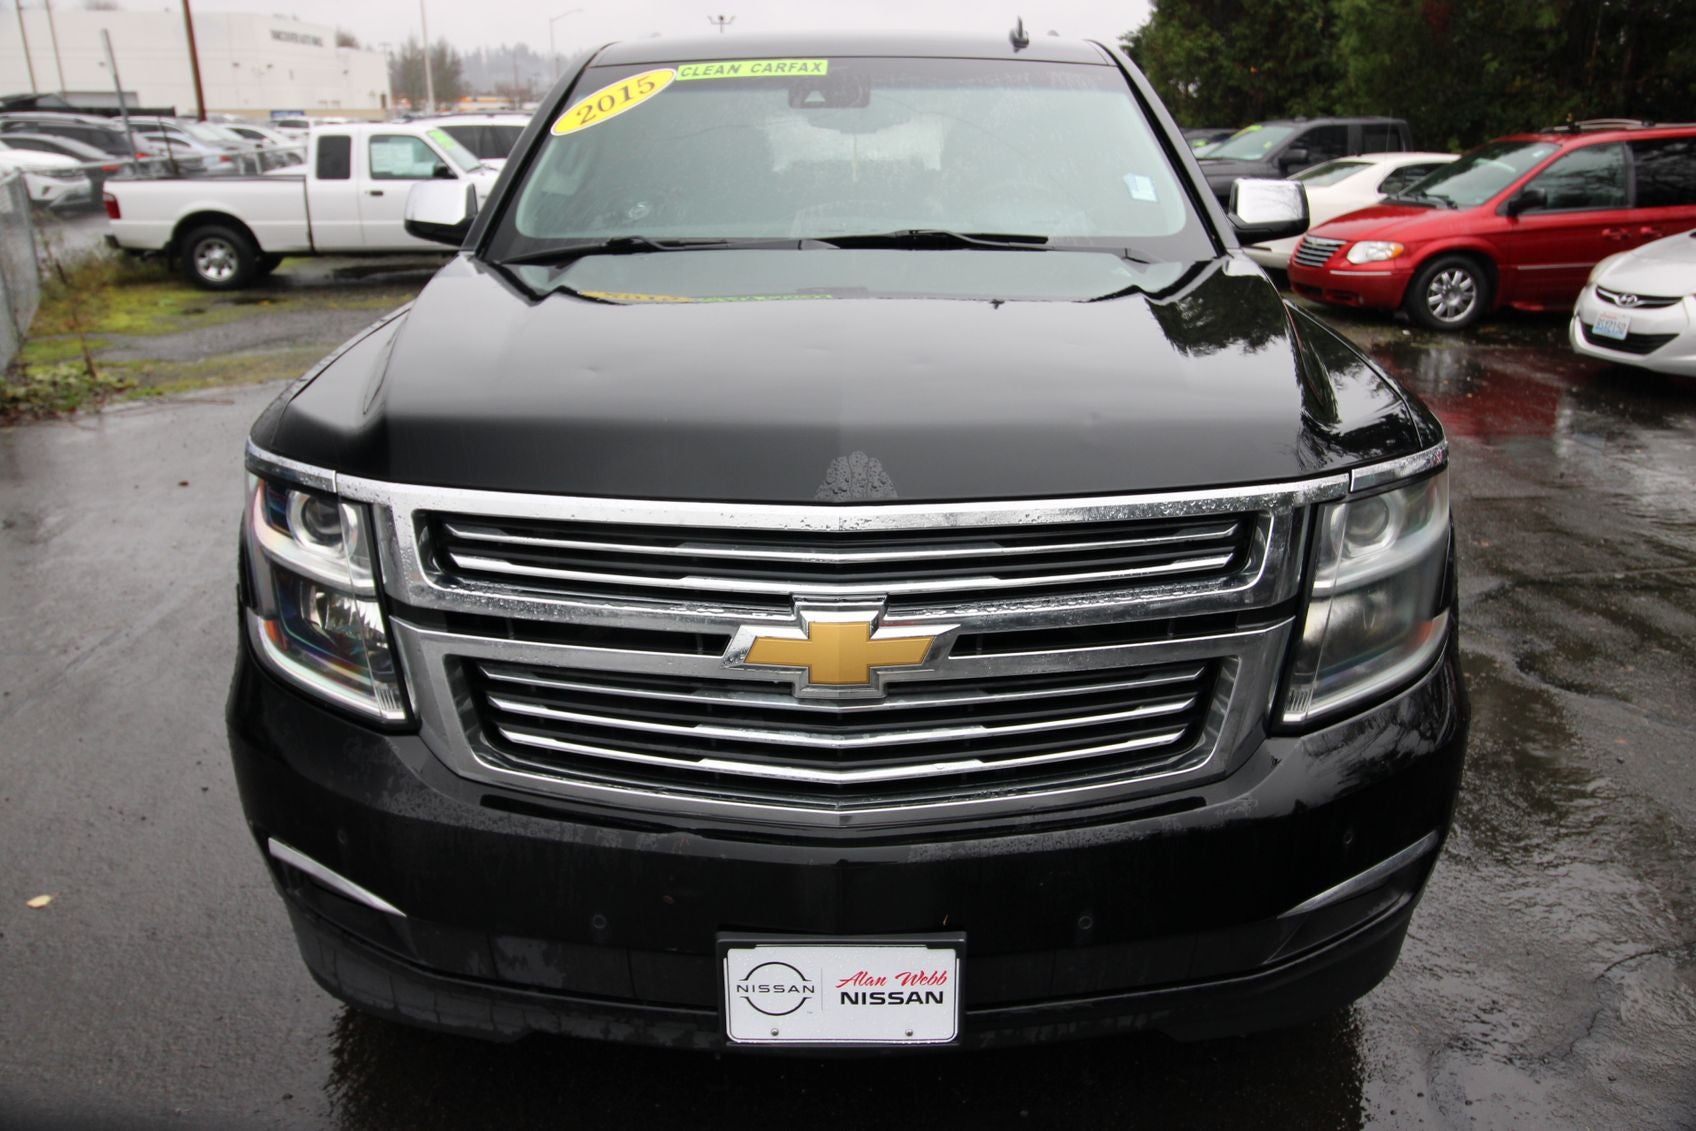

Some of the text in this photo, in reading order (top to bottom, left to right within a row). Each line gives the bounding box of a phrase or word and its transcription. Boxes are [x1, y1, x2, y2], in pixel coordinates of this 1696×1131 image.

[680, 61, 823, 77] CLEAN CARFAX
[576, 76, 656, 126] 2015
[835, 969, 948, 989] Alan Webb
[736, 984, 815, 994] NISSAN
[840, 990, 944, 1006] NISSAN
